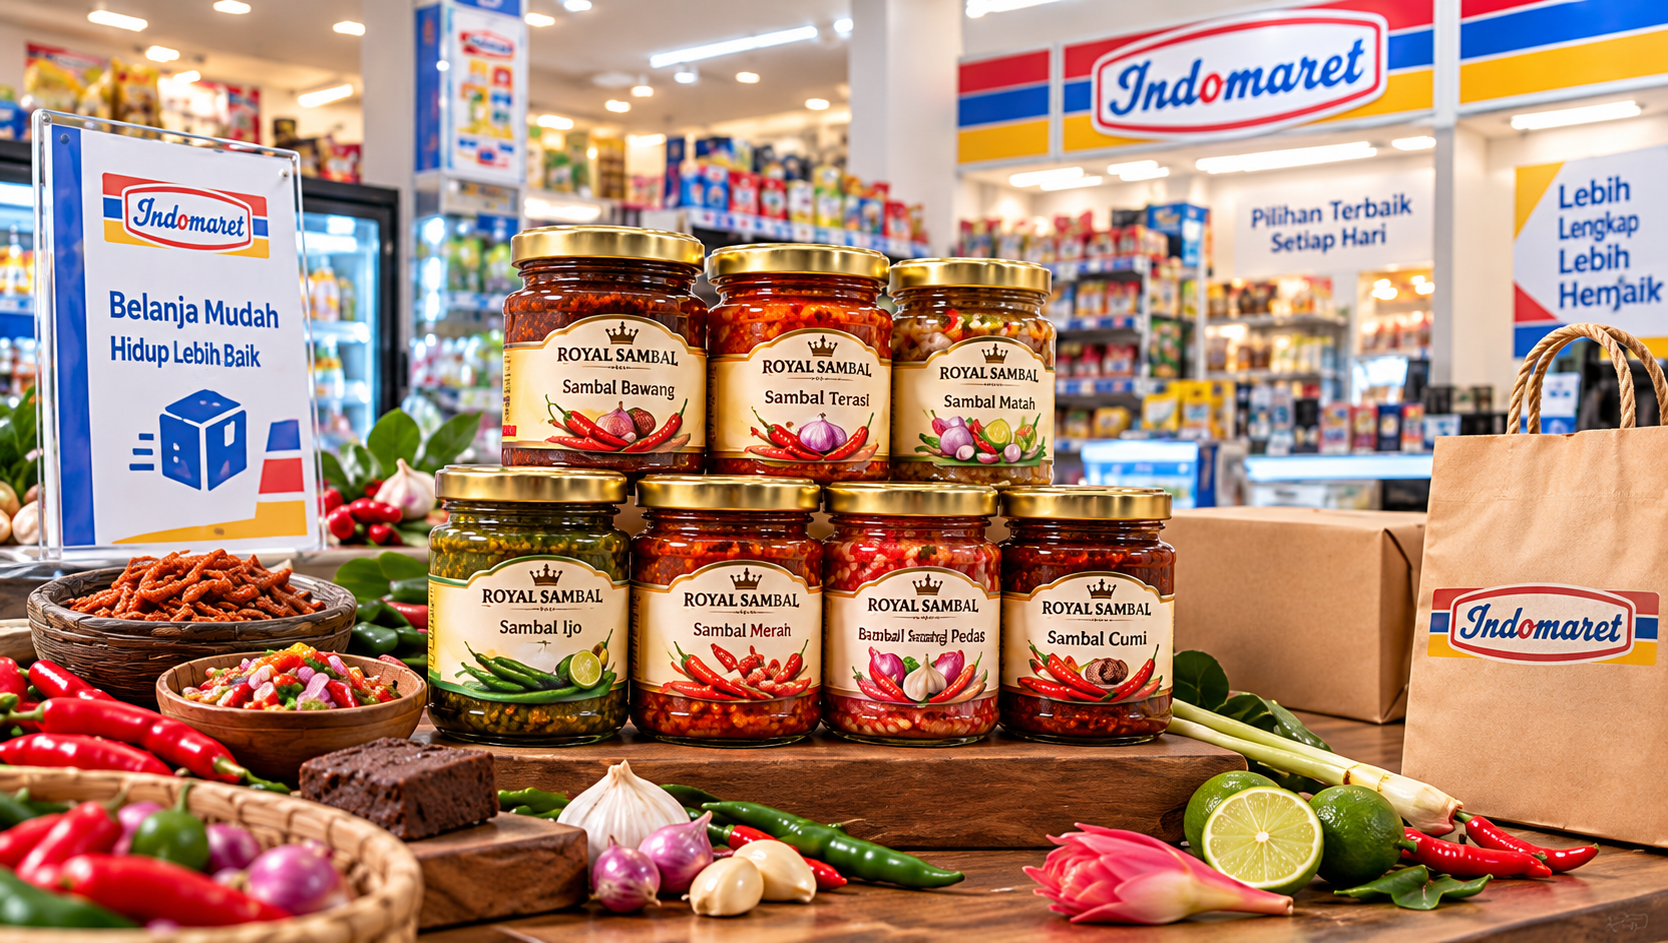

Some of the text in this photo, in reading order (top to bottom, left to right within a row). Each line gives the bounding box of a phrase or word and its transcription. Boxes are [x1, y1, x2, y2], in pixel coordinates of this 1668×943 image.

[1109, 38, 1365, 117] Indomaret
[1559, 176, 1630, 210] Lebih
[132, 197, 245, 238] Indomaret
[1251, 192, 1412, 229] Pilihan Terbaik
[1559, 211, 1640, 242] Lengkap
[1271, 222, 1386, 254] Setiap Hari
[1559, 243, 1630, 274] Lebih
[109, 290, 279, 329] Belanja Mudah
[110, 336, 261, 368] Hidup Lebih Baik
[556, 347, 679, 366] ROYAL SAMBAL
[762, 360, 872, 378] ROYAL SAMBAL
[940, 366, 1039, 383] ROYAL SAMBAL
[562, 379, 675, 400] Sambal Bawang
[765, 390, 870, 407] Sambal Terasi
[944, 394, 1036, 410] Sambal Matah
[482, 588, 603, 604] ROYAL SAMBAL
[683, 592, 800, 608] ROYAL SAMBAL
[867, 597, 979, 613] ROYAL SAMBAL
[1042, 601, 1152, 616] ROYAL SAMBAL
[499, 619, 582, 638] Sambal Ijo
[693, 622, 747, 637] Sambal
[1459, 602, 1623, 643] Indomaret
[951, 628, 986, 643] Pedas
[1047, 630, 1148, 646] Sambal Cumi
